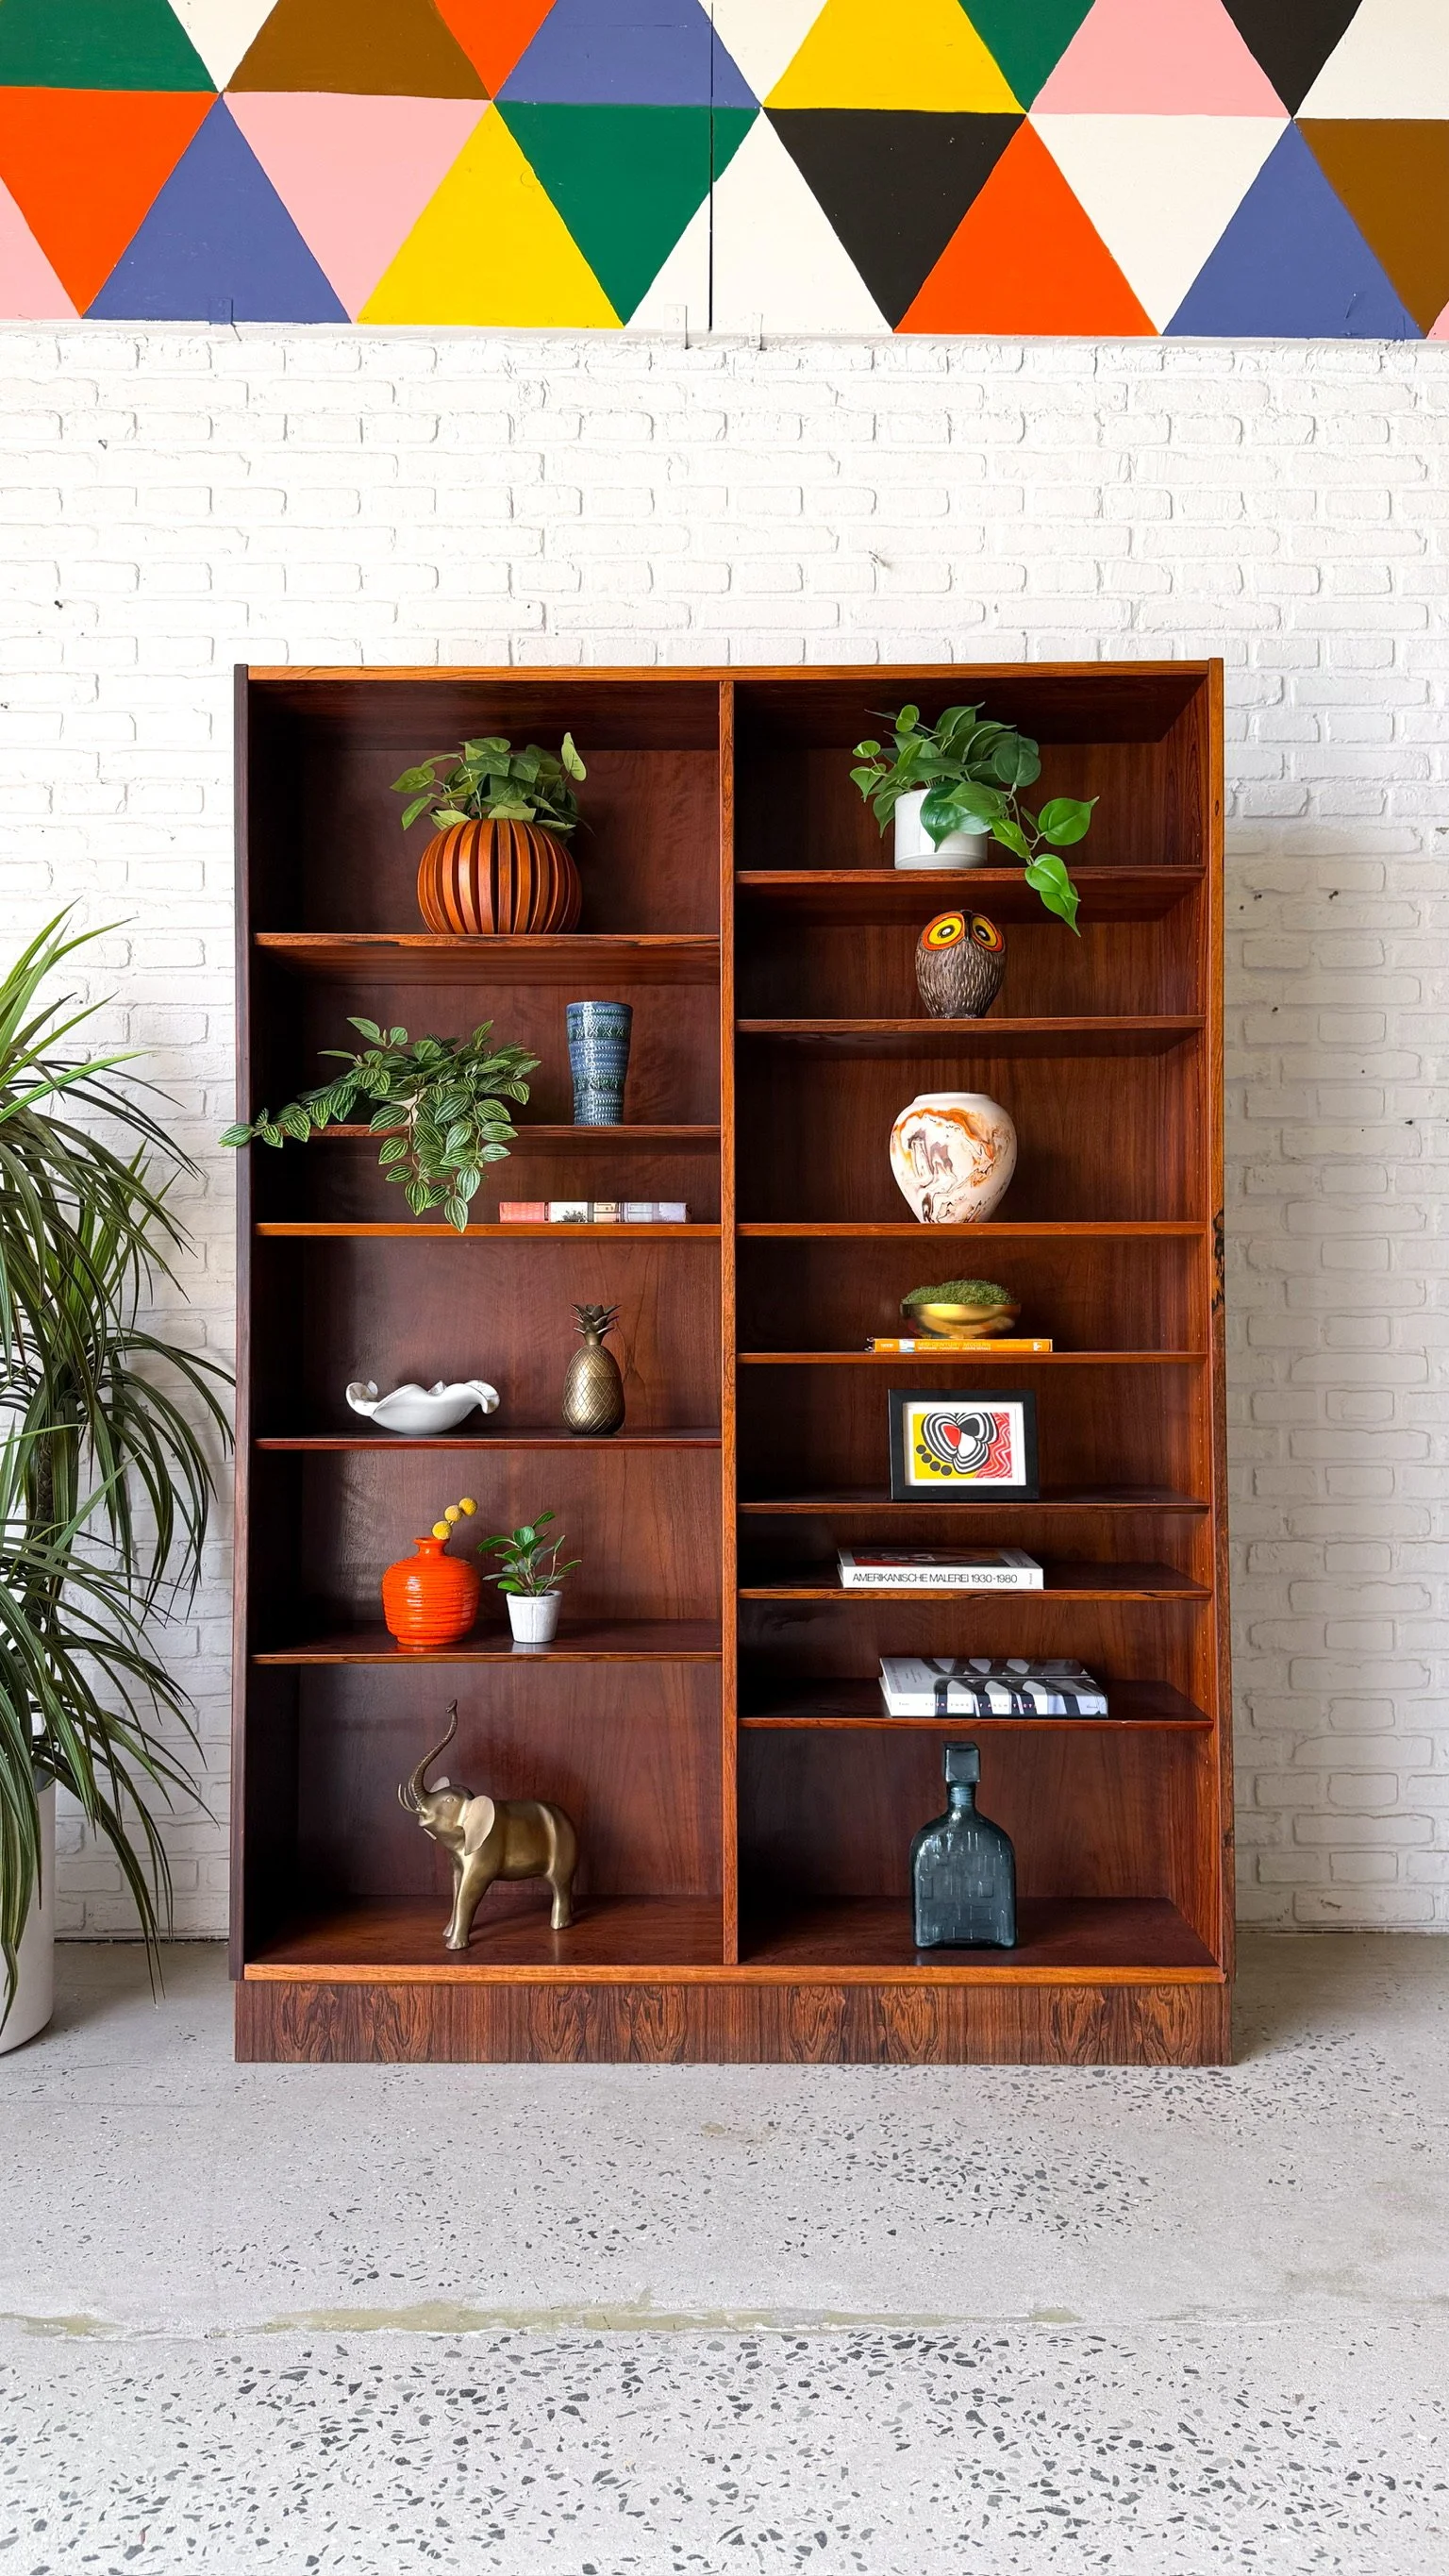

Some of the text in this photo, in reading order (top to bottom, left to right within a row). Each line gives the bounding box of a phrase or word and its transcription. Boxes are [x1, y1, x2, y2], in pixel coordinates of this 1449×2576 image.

[852, 1573, 928, 1583] AMERIKANISCHE
[929, 1573, 969, 1583] MALEREI
[971, 1573, 1018, 1583] 1930-1980
